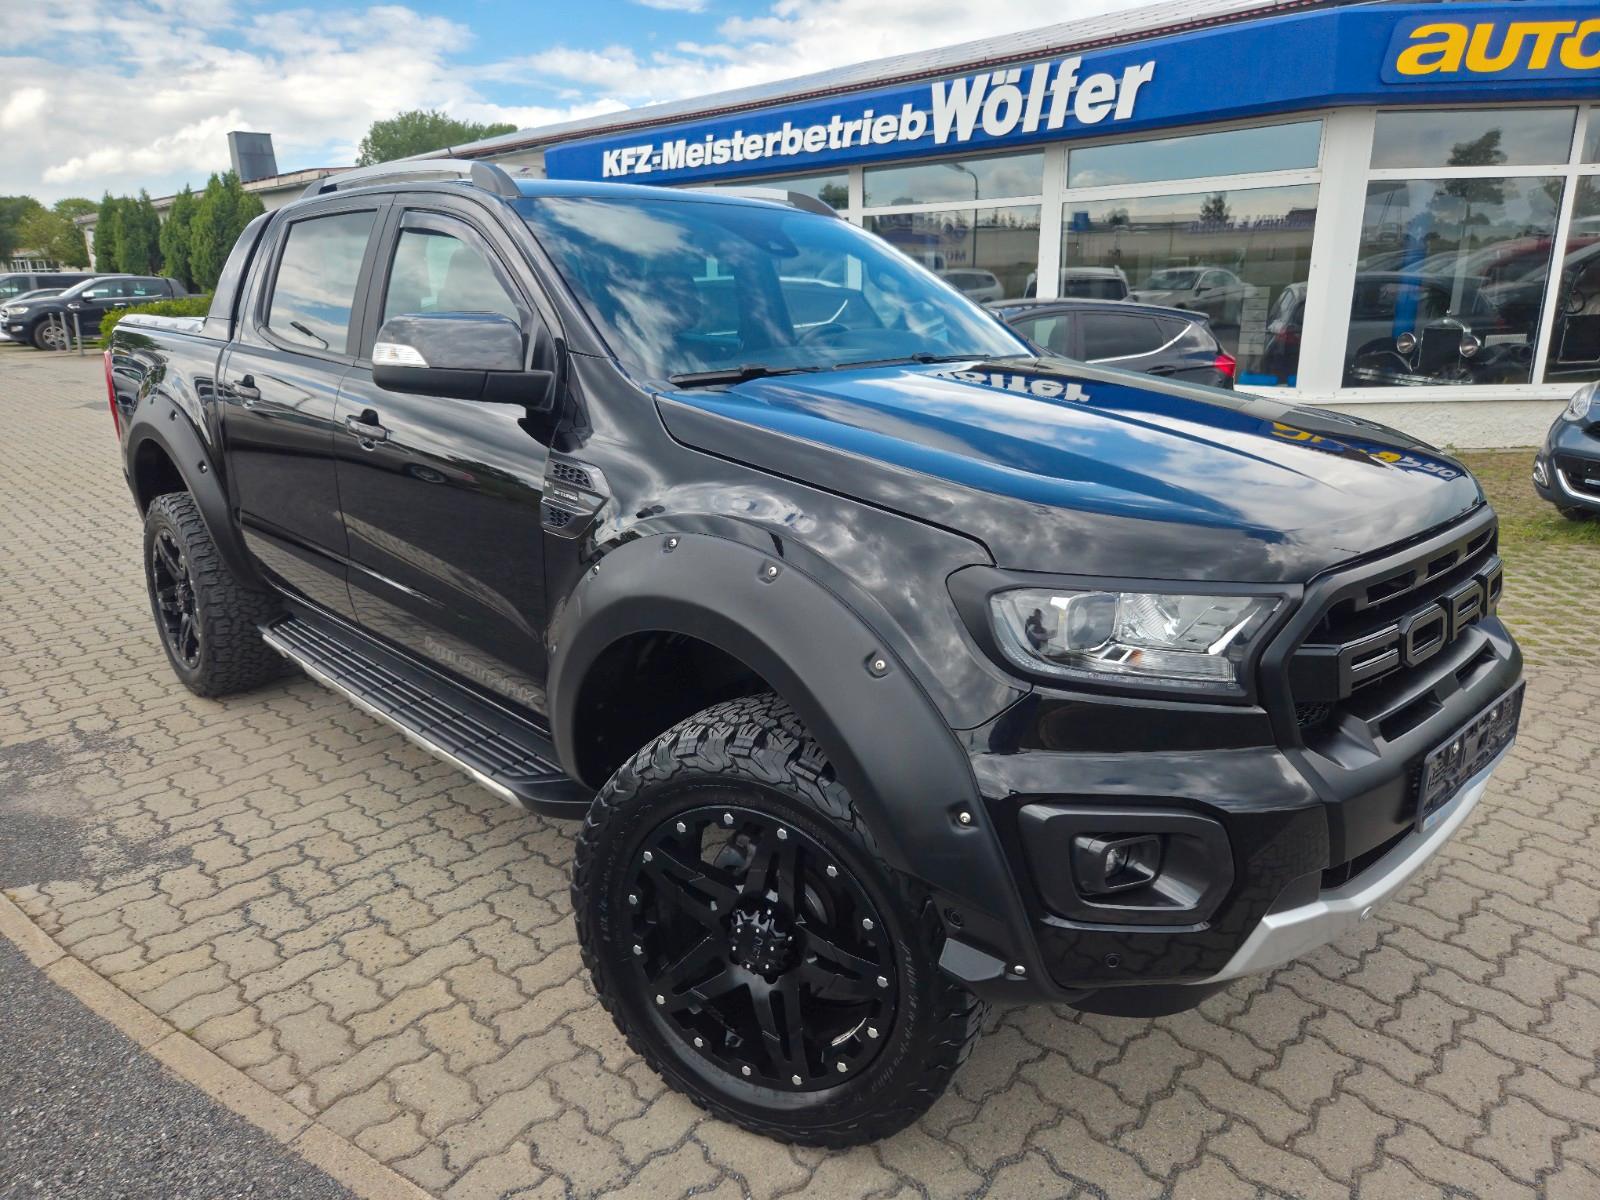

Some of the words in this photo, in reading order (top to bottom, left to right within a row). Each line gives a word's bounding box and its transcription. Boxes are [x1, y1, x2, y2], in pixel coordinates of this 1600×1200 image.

[1396, 18, 1600, 76] auto
[602, 103, 928, 178] KFZ-Meisterbetrieb
[931, 56, 1156, 144] Wölfer
